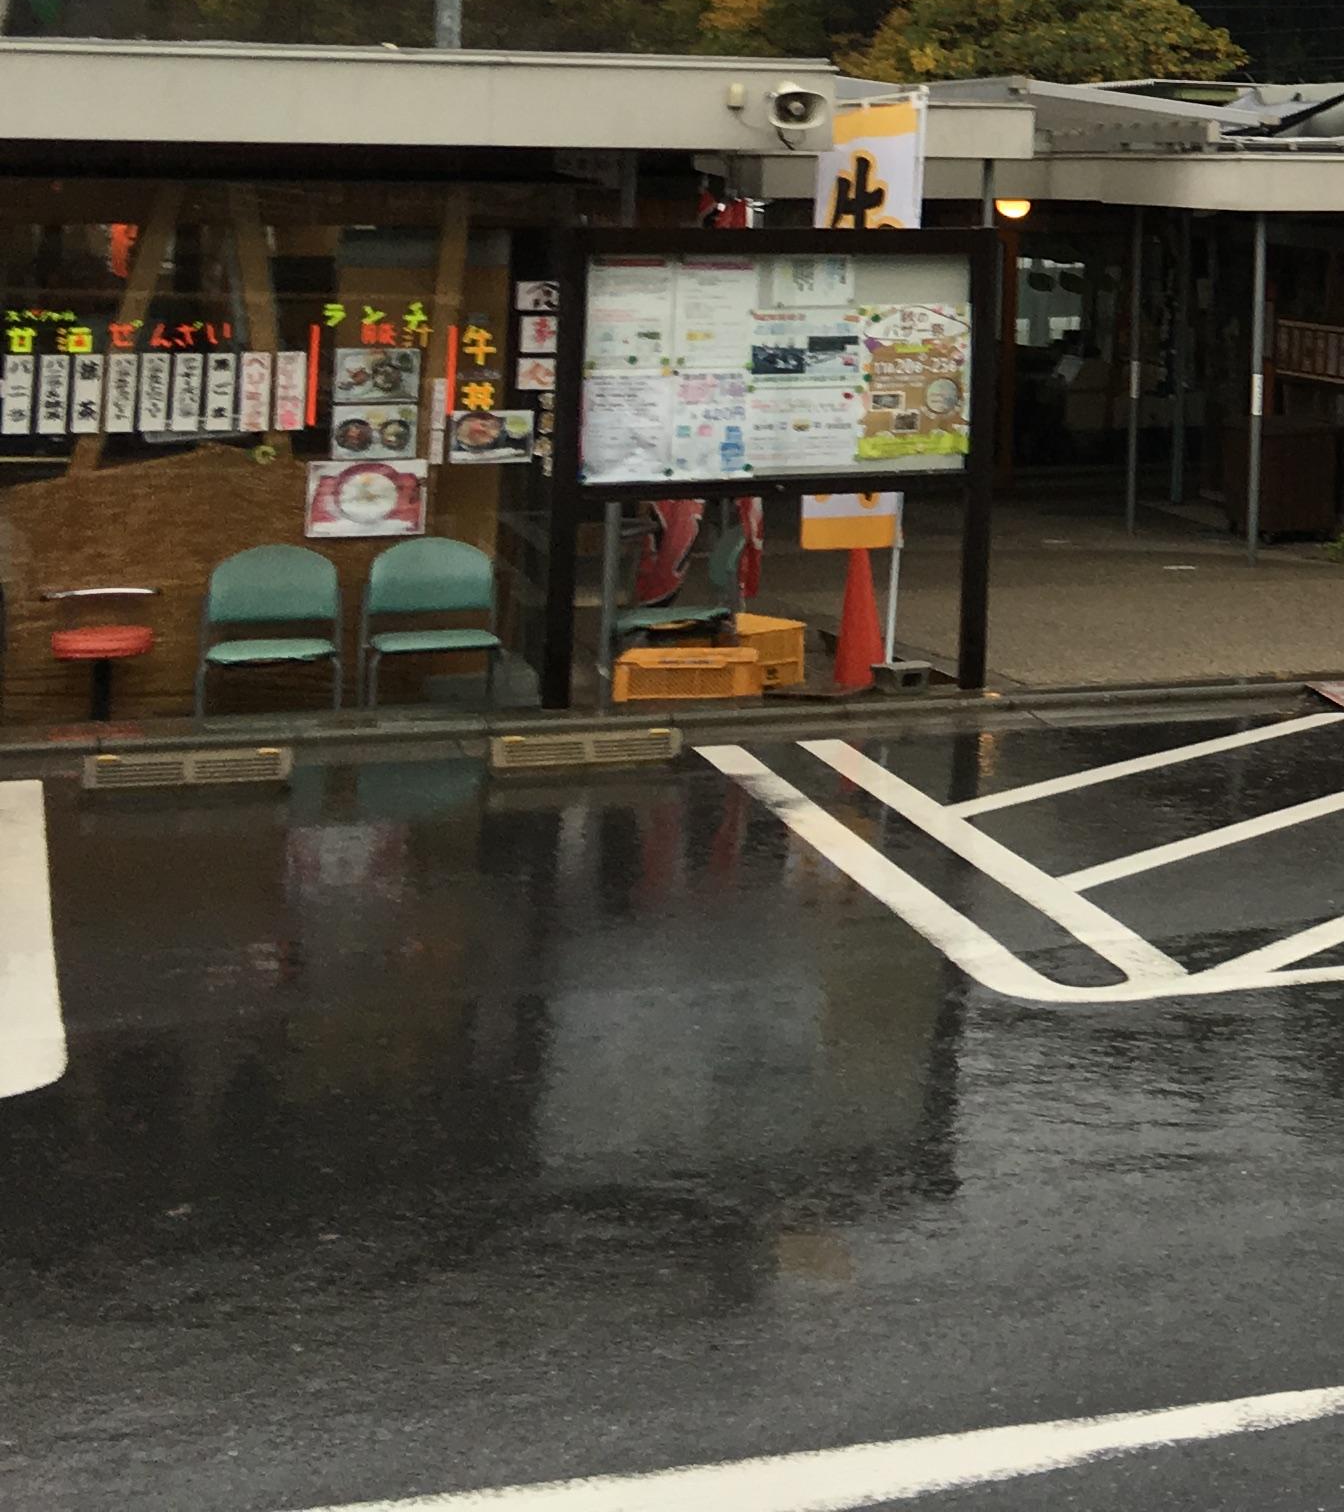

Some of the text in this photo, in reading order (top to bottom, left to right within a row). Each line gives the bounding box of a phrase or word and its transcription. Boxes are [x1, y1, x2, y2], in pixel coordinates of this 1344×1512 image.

[323, 301, 428, 330] ランチ
[6, 326, 93, 353] 甘酒
[107, 319, 232, 348] ぜんざい
